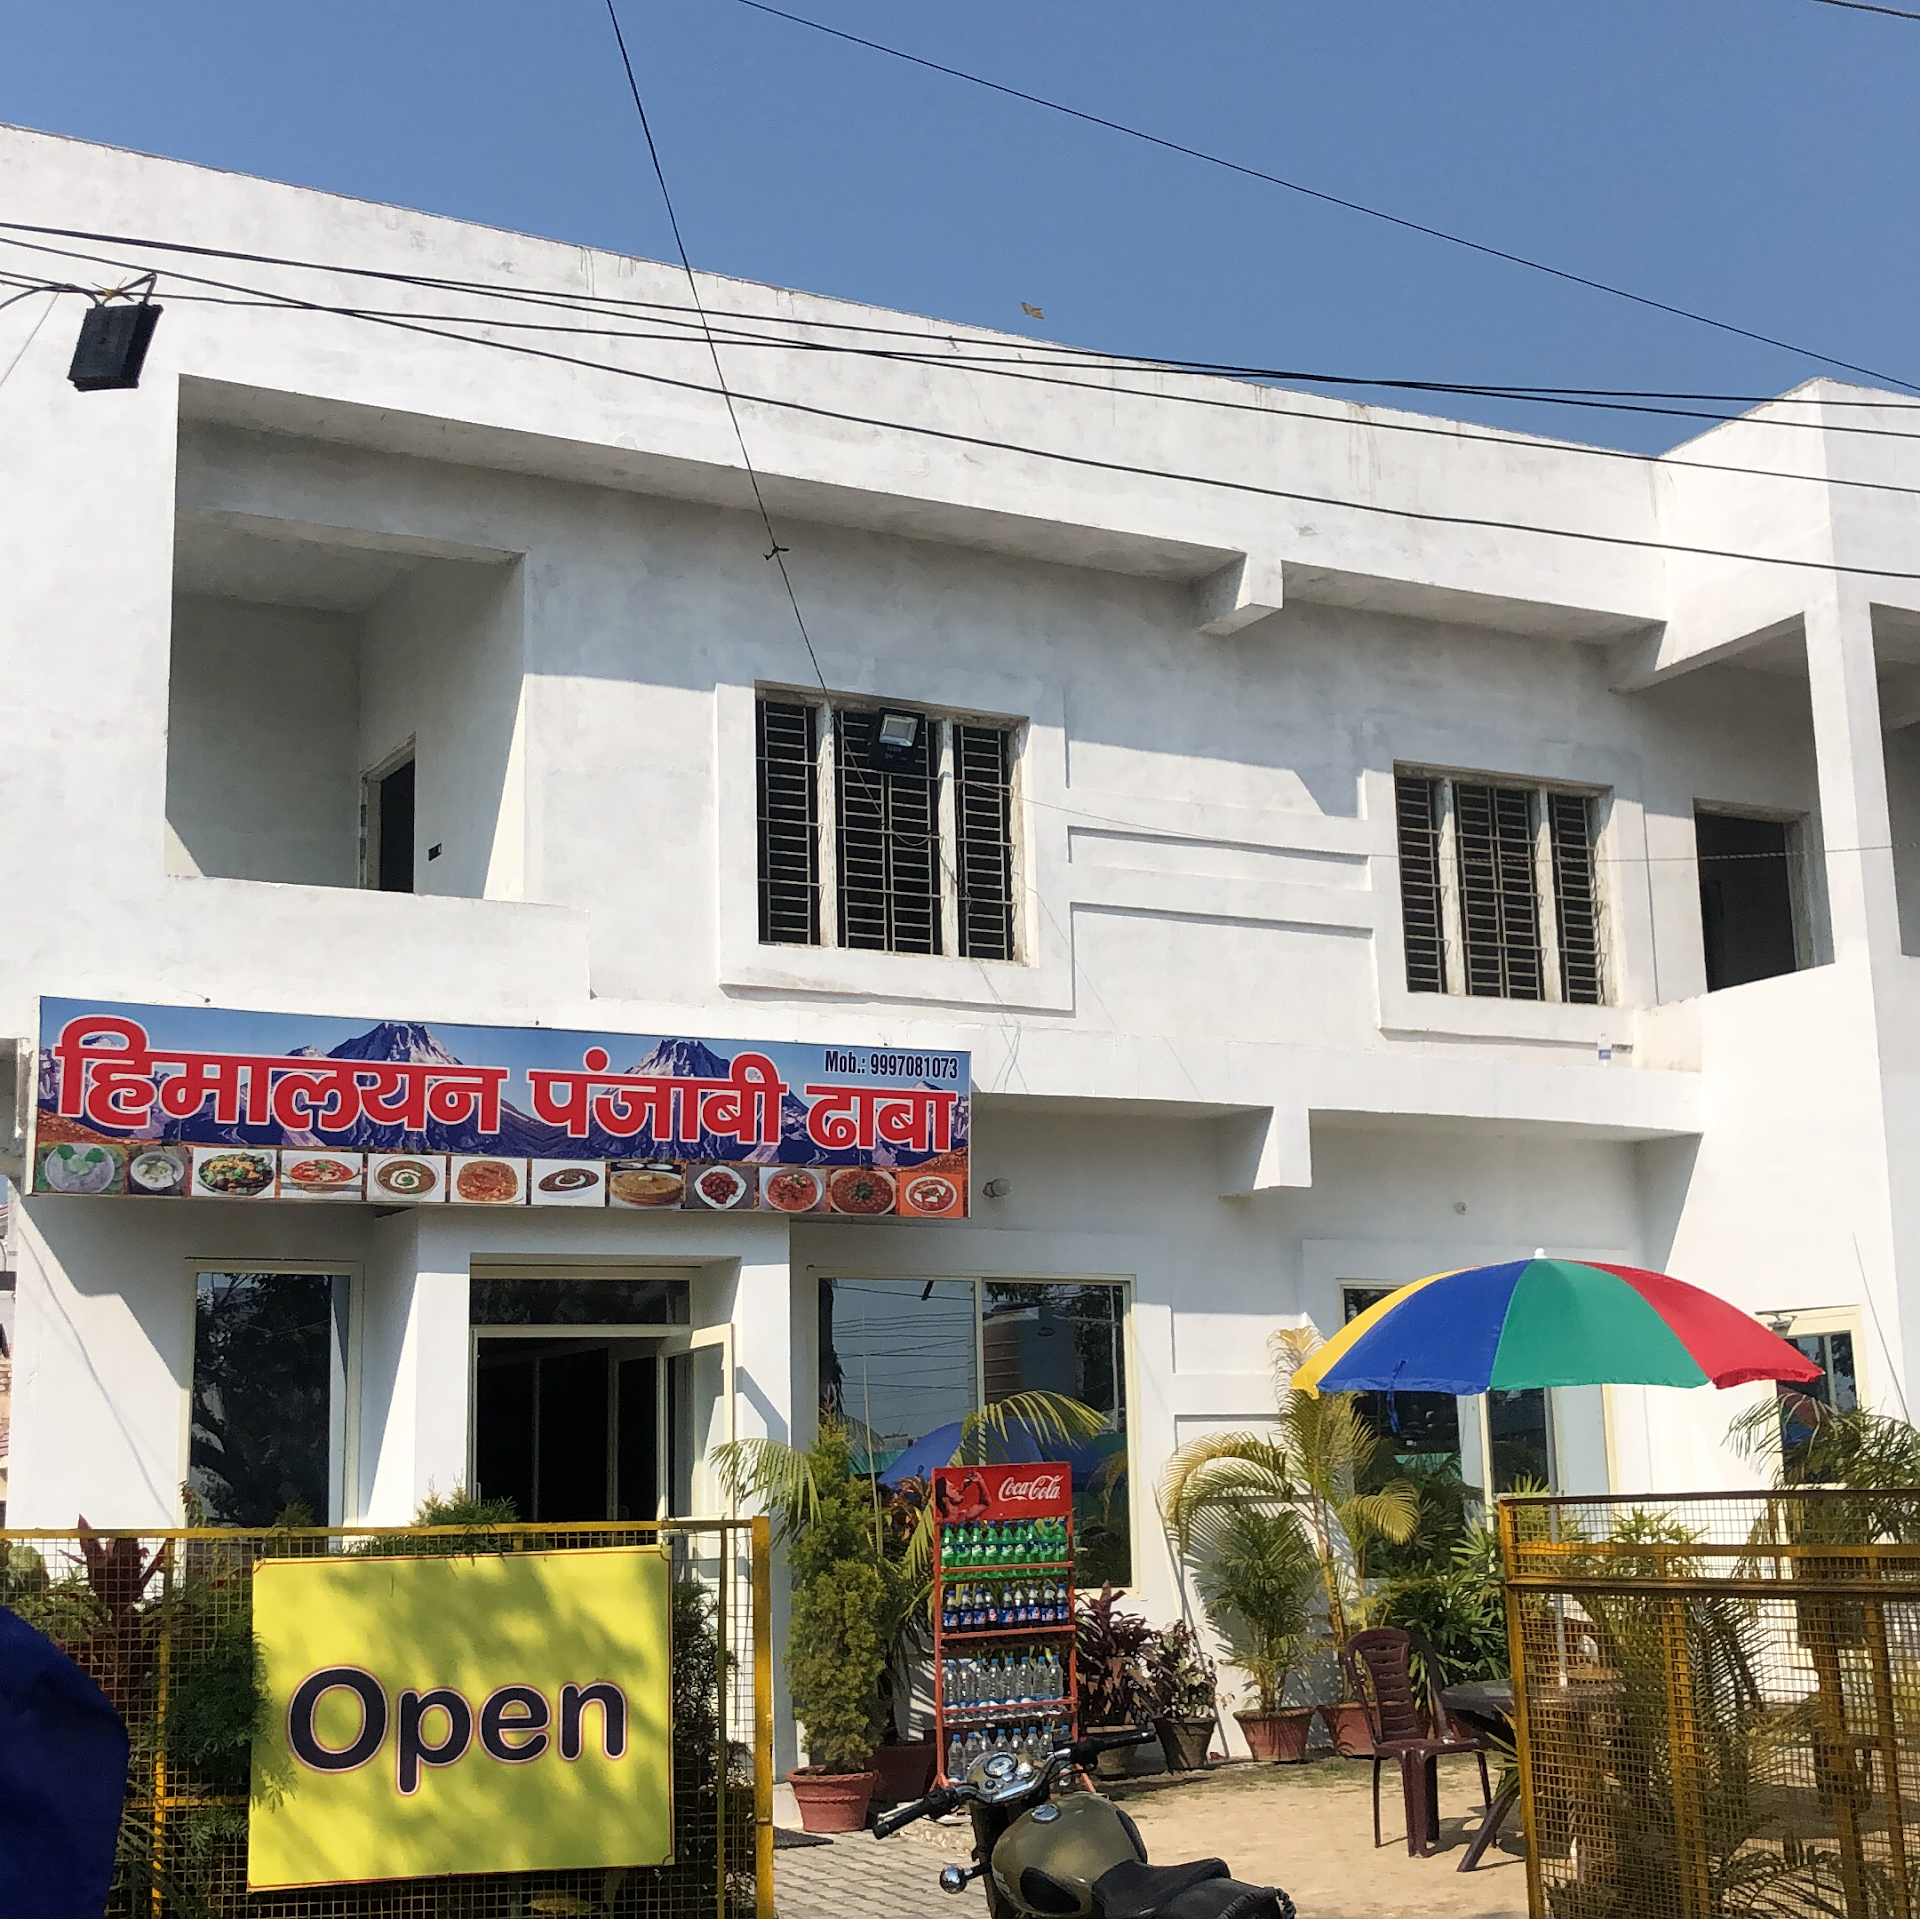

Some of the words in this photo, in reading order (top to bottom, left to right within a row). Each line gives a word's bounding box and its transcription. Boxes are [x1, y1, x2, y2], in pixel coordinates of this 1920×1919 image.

[53, 1014, 509, 1134] हिमालयन
[528, 1047, 789, 1146] पंजाबी
[805, 1084, 958, 1152] ढाबा
[824, 1049, 866, 1074] Mob.:
[870, 1053, 958, 1079] 9997081073
[998, 1475, 1064, 1502] Coca-Cola
[288, 1666, 627, 1795] Open
